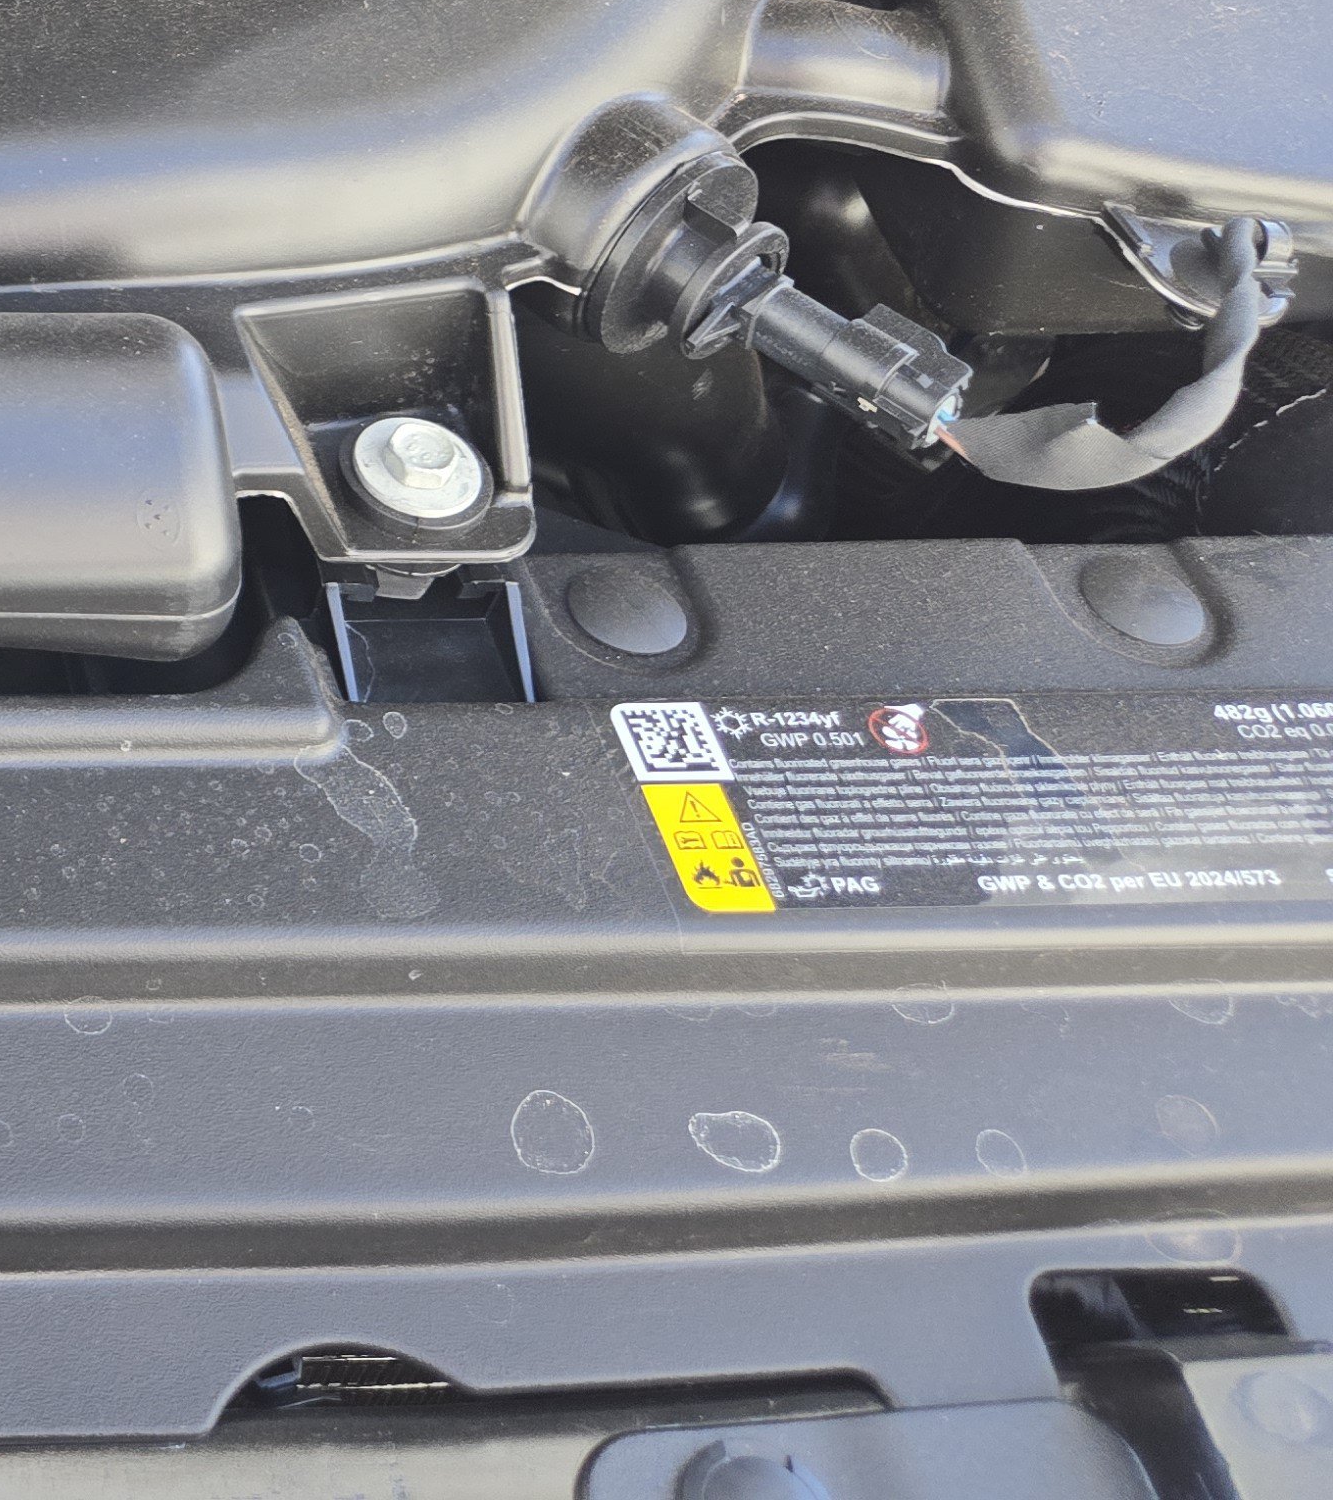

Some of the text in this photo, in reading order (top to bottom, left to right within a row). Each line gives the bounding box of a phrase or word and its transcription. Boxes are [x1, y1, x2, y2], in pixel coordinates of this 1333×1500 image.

[750, 711, 841, 729] R-1234yf
[1213, 704, 1273, 723] 482g
[760, 731, 866, 748] GWP 0.501
[1237, 725, 1283, 739] CO2
[1284, 726, 1312, 741] eq
[831, 876, 881, 894] PAG
[977, 868, 1282, 894] GWP & CO2 per EU 2024/573
